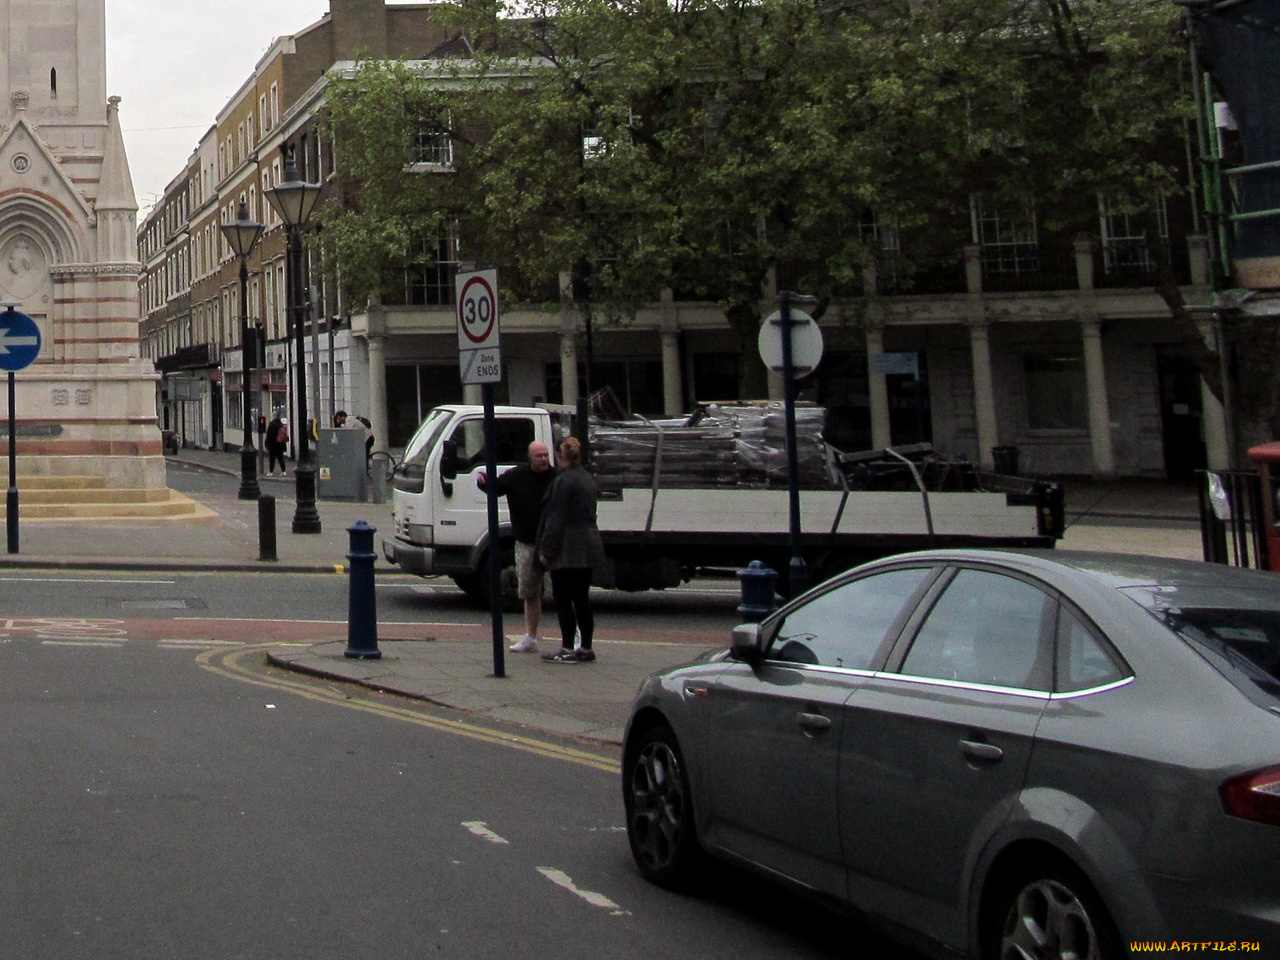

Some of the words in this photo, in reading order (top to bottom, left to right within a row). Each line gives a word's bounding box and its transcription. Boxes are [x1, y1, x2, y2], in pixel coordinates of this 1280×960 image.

[465, 296, 490, 324] 30
[481, 354, 494, 362] Zone
[477, 365, 499, 376] ENDS
